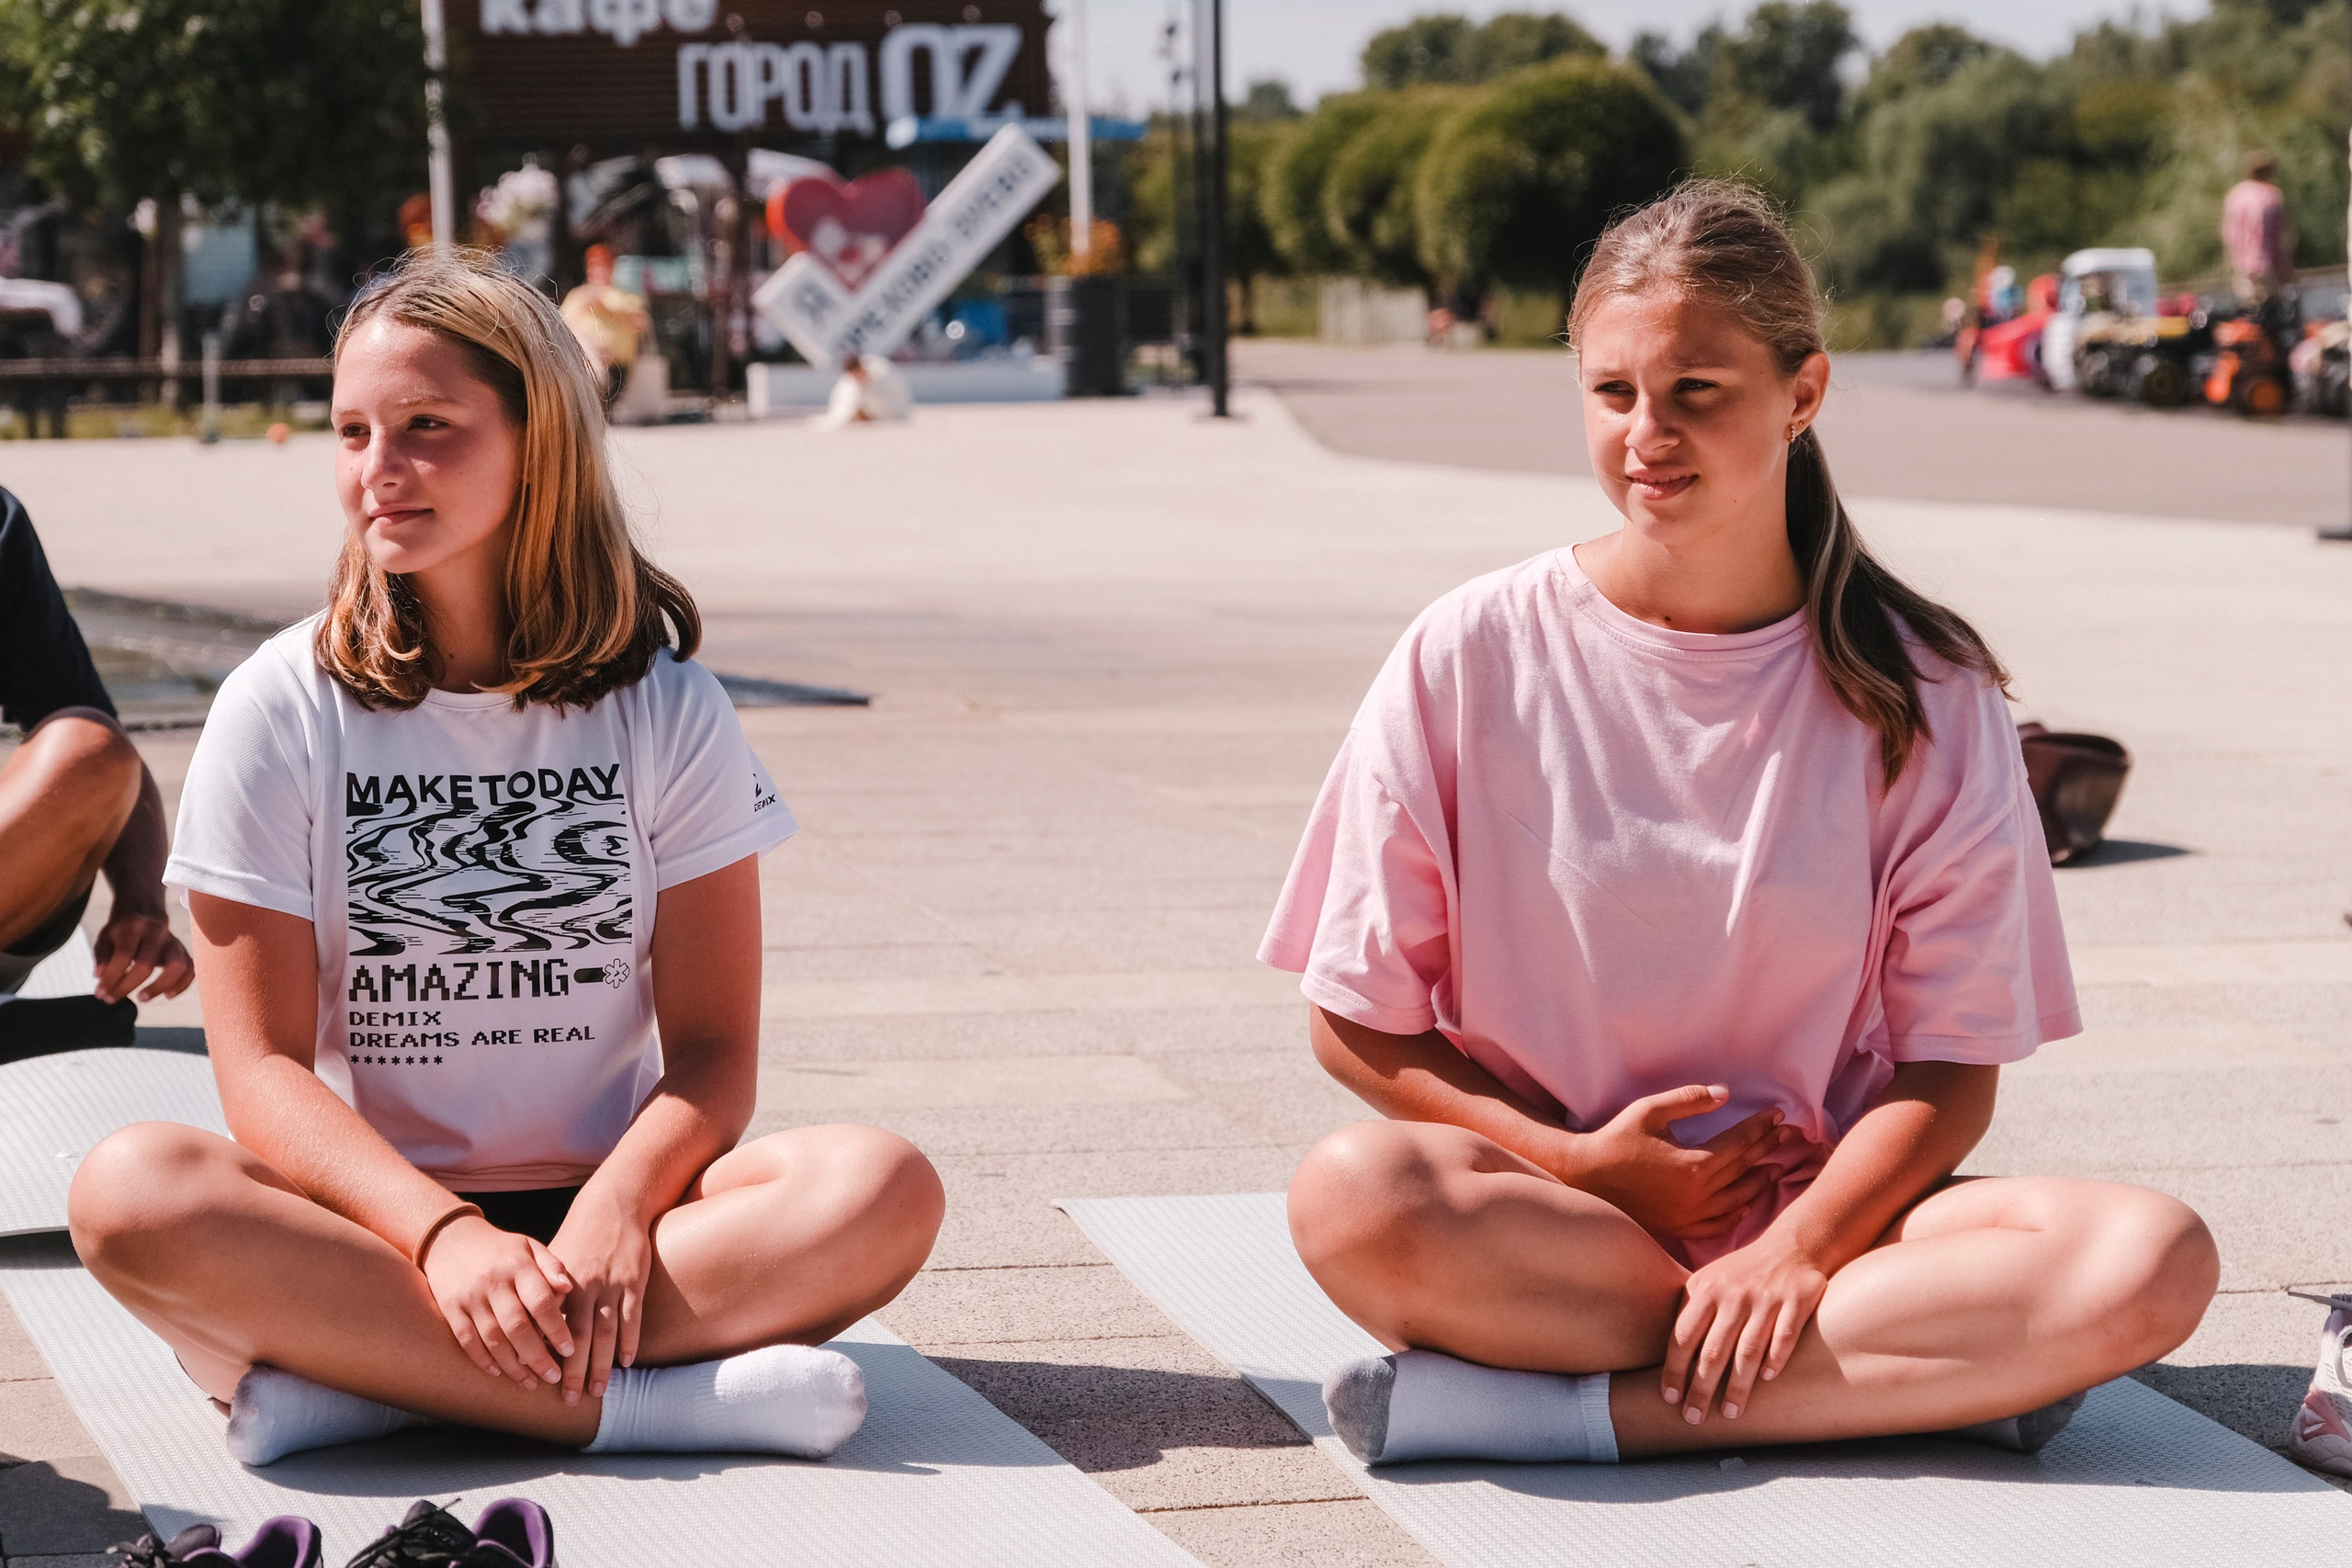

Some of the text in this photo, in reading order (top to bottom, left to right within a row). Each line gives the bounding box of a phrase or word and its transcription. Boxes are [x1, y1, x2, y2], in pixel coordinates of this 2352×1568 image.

[677, 22, 1023, 136] ГОРОД OZ
[348, 958, 570, 1002] AMAZING
[348, 1010, 442, 1027] DEMIX
[349, 1025, 596, 1048] DREAMS ARE REAL
